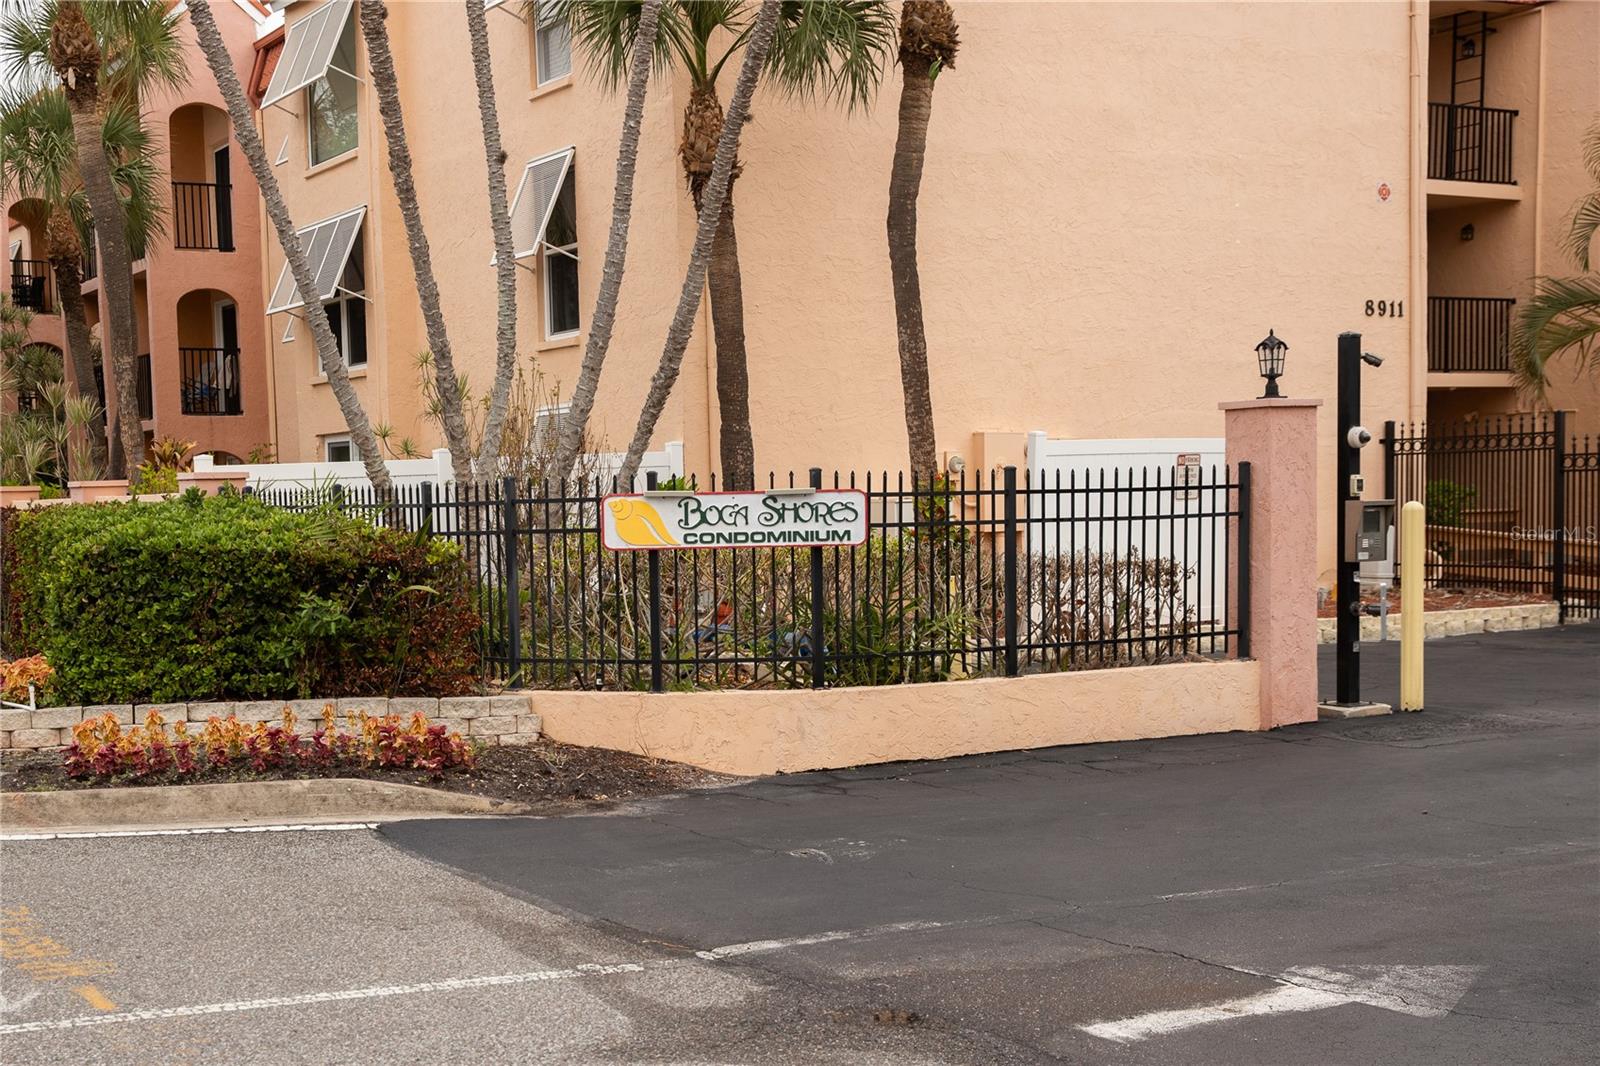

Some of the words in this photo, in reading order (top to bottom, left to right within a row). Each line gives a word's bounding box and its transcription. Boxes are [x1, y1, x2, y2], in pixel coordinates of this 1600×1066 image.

[1364, 299, 1404, 318] 8911
[757, 495, 859, 527] SHORES
[683, 530, 851, 545] CONDOMINIUM
